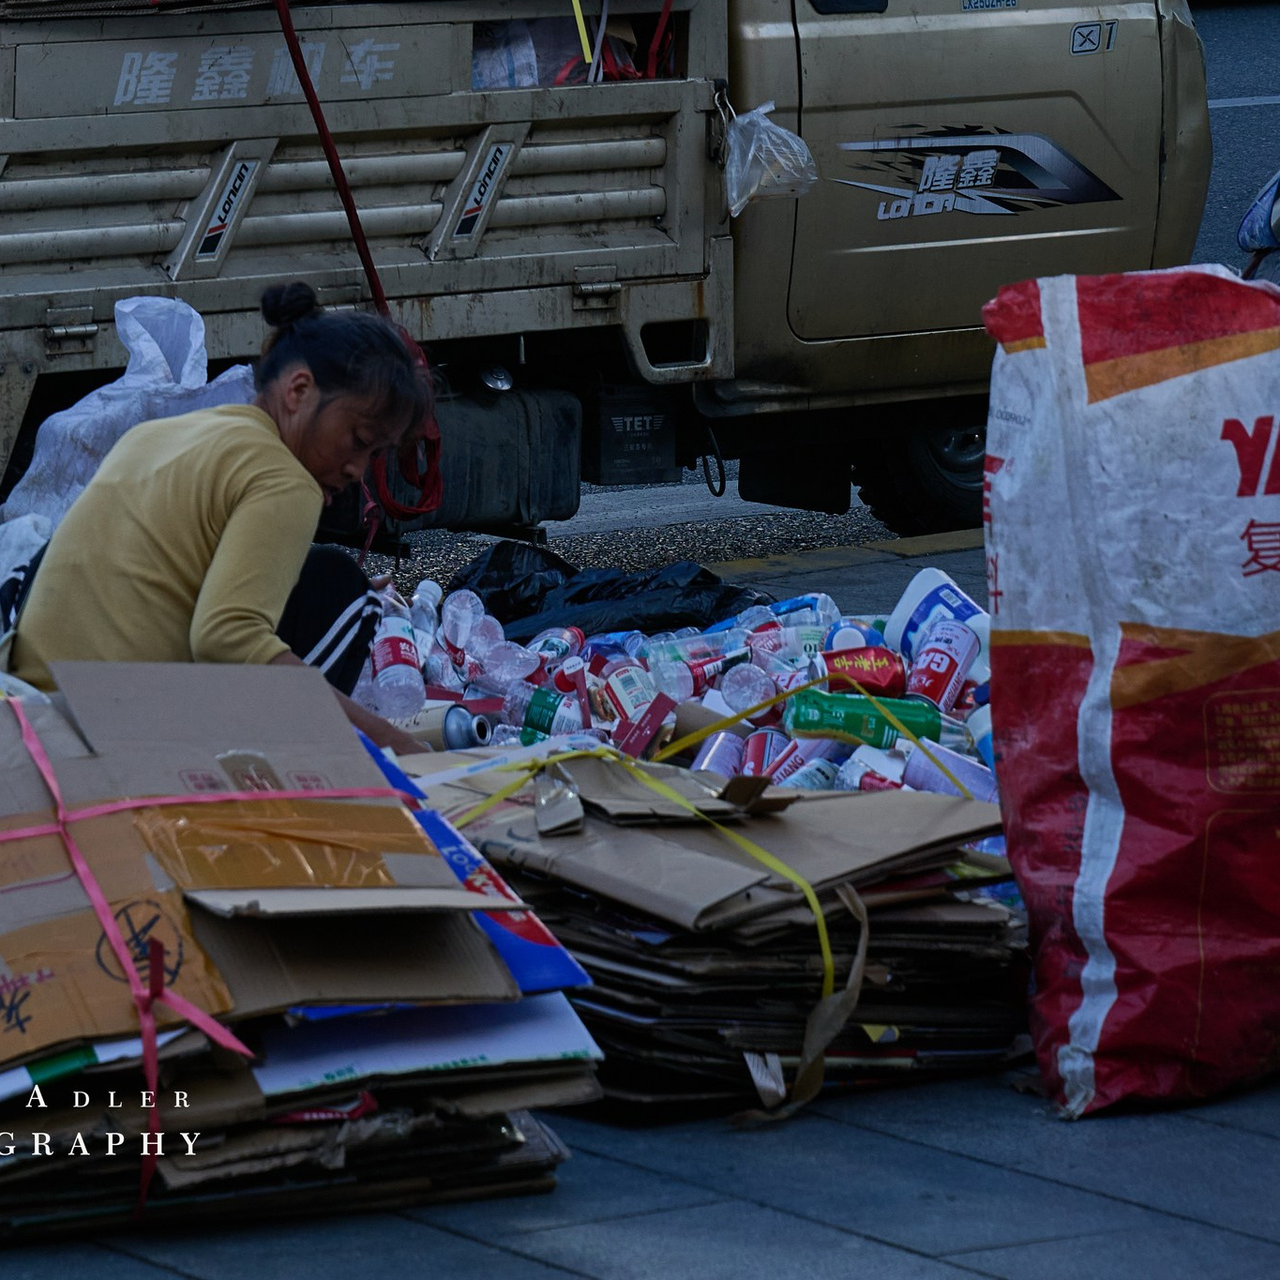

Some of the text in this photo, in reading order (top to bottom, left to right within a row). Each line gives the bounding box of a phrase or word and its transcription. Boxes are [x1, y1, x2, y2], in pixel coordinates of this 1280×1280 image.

[113, 38, 401, 106] 隆鑫机车
[218, 162, 250, 224] LONCIN
[474, 147, 504, 206] LONCIN
[918, 150, 1001, 192] 隆鑫
[1221, 415, 1280, 497] Y
